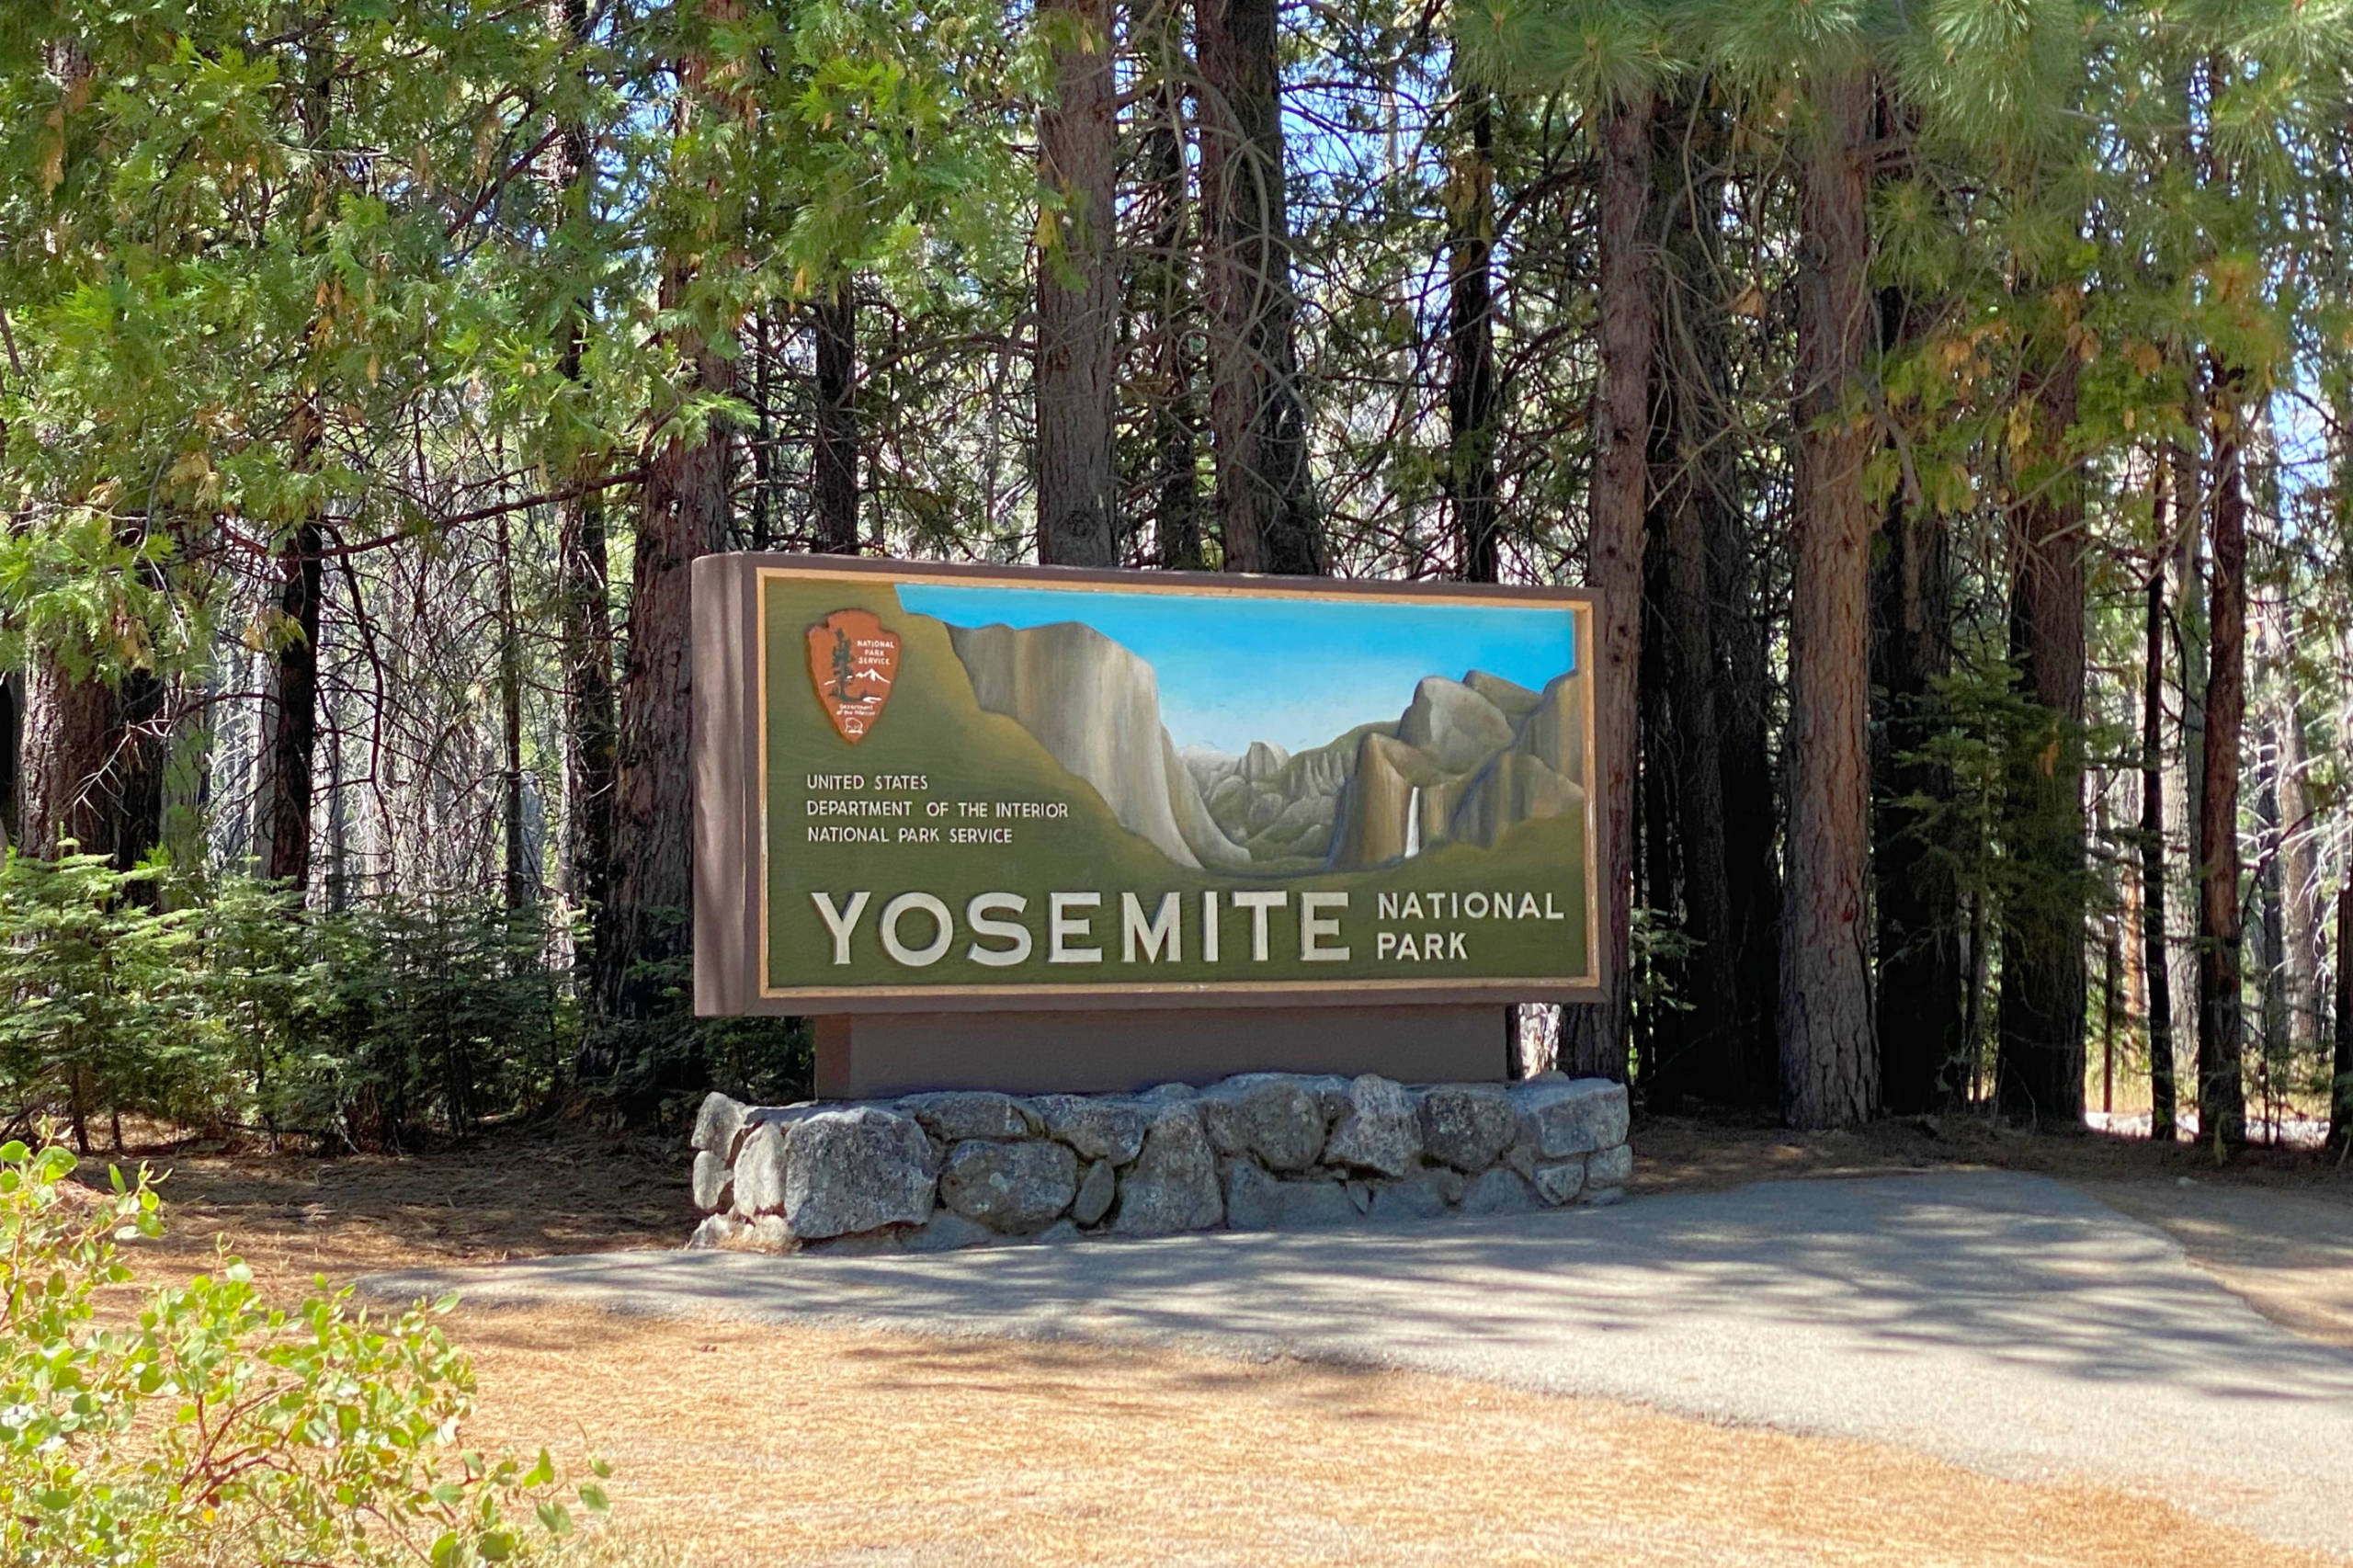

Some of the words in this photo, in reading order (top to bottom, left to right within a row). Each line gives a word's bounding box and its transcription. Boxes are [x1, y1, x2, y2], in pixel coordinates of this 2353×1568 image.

[857, 640, 895, 649] NATIONAL
[858, 656, 891, 665] SERVICE
[807, 774, 865, 790] UNITED
[874, 775, 928, 790] STATES
[806, 800, 913, 816] DEPARTMENT
[926, 801, 949, 817] OF
[958, 801, 988, 818] THE
[995, 801, 1068, 818] INTERIOR
[808, 826, 890, 843] NATIONAL
[898, 827, 939, 843] PARK
[949, 827, 1012, 844] SERVICE
[1377, 892, 1564, 919] NATIONAL
[810, 891, 1350, 967] YOSEMITE
[1377, 932, 1468, 960] PARK
